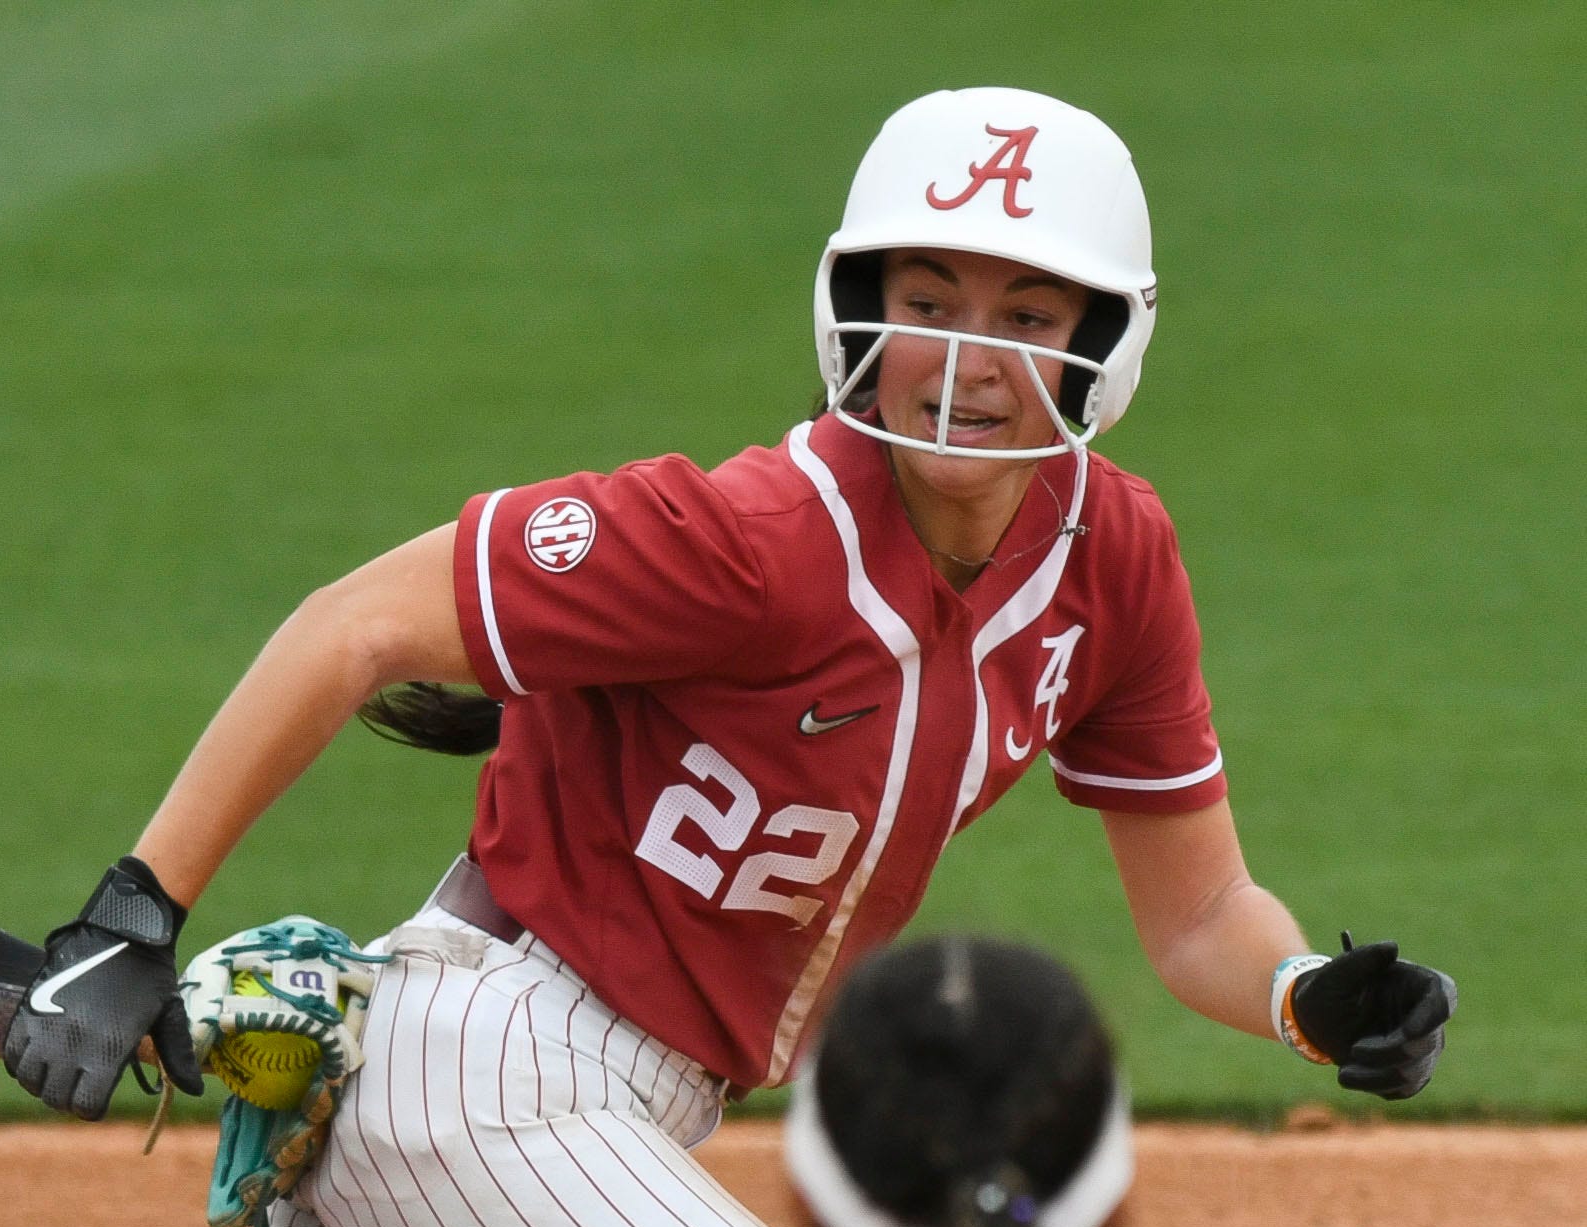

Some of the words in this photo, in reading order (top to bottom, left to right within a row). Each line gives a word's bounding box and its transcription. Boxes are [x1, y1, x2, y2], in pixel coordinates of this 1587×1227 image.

[926, 123, 1039, 219] A
[530, 502, 591, 567] SEC
[1005, 624, 1086, 761] A
[634, 743, 860, 927] 22
